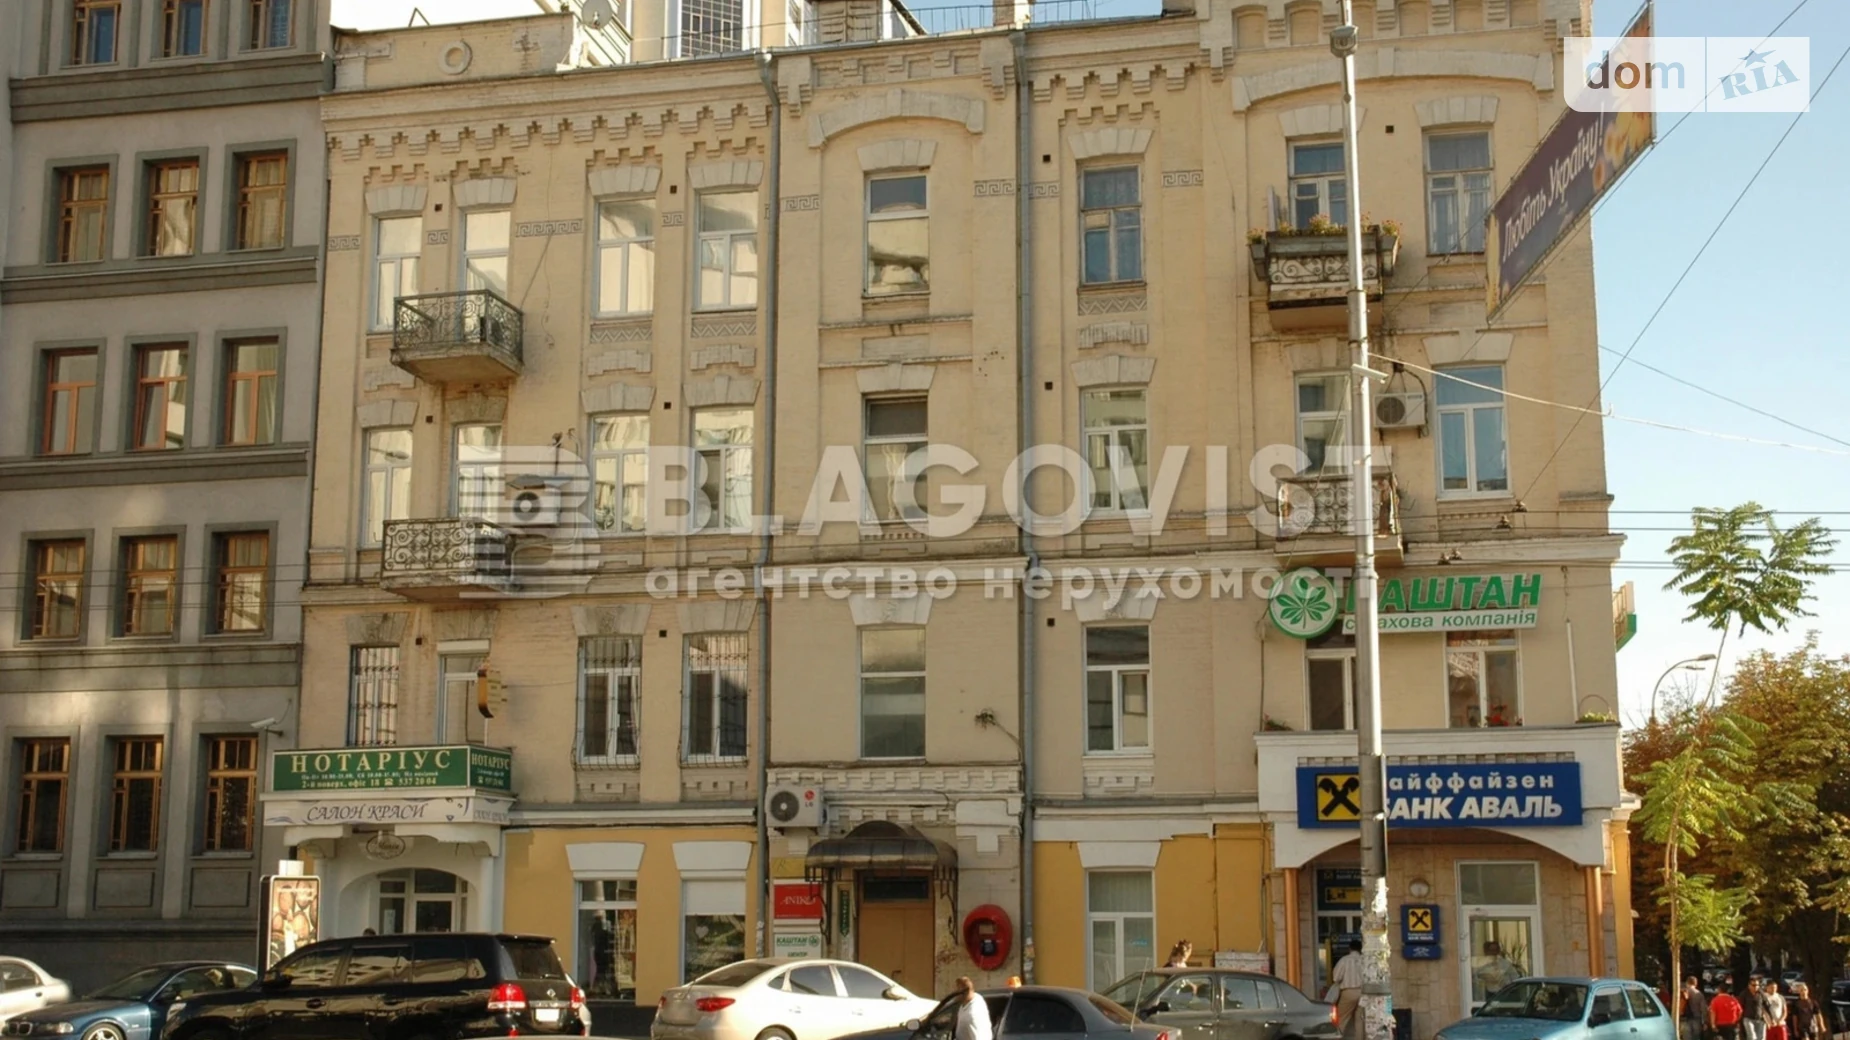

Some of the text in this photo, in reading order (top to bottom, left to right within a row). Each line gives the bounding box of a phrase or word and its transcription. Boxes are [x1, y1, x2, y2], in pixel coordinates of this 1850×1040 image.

[1502, 188, 1547, 263] Любіть
[1345, 574, 1542, 613] АШТАН
[1345, 610, 1536, 630] сахова компанія
[291, 750, 450, 772] НОТАРІУС
[471, 752, 510, 770] НОТАРІУС
[1389, 772, 1554, 794] айффайзен
[306, 803, 428, 821] САЛОН КРАСИ
[1458, 796, 1562, 819] АВАЛЬ
